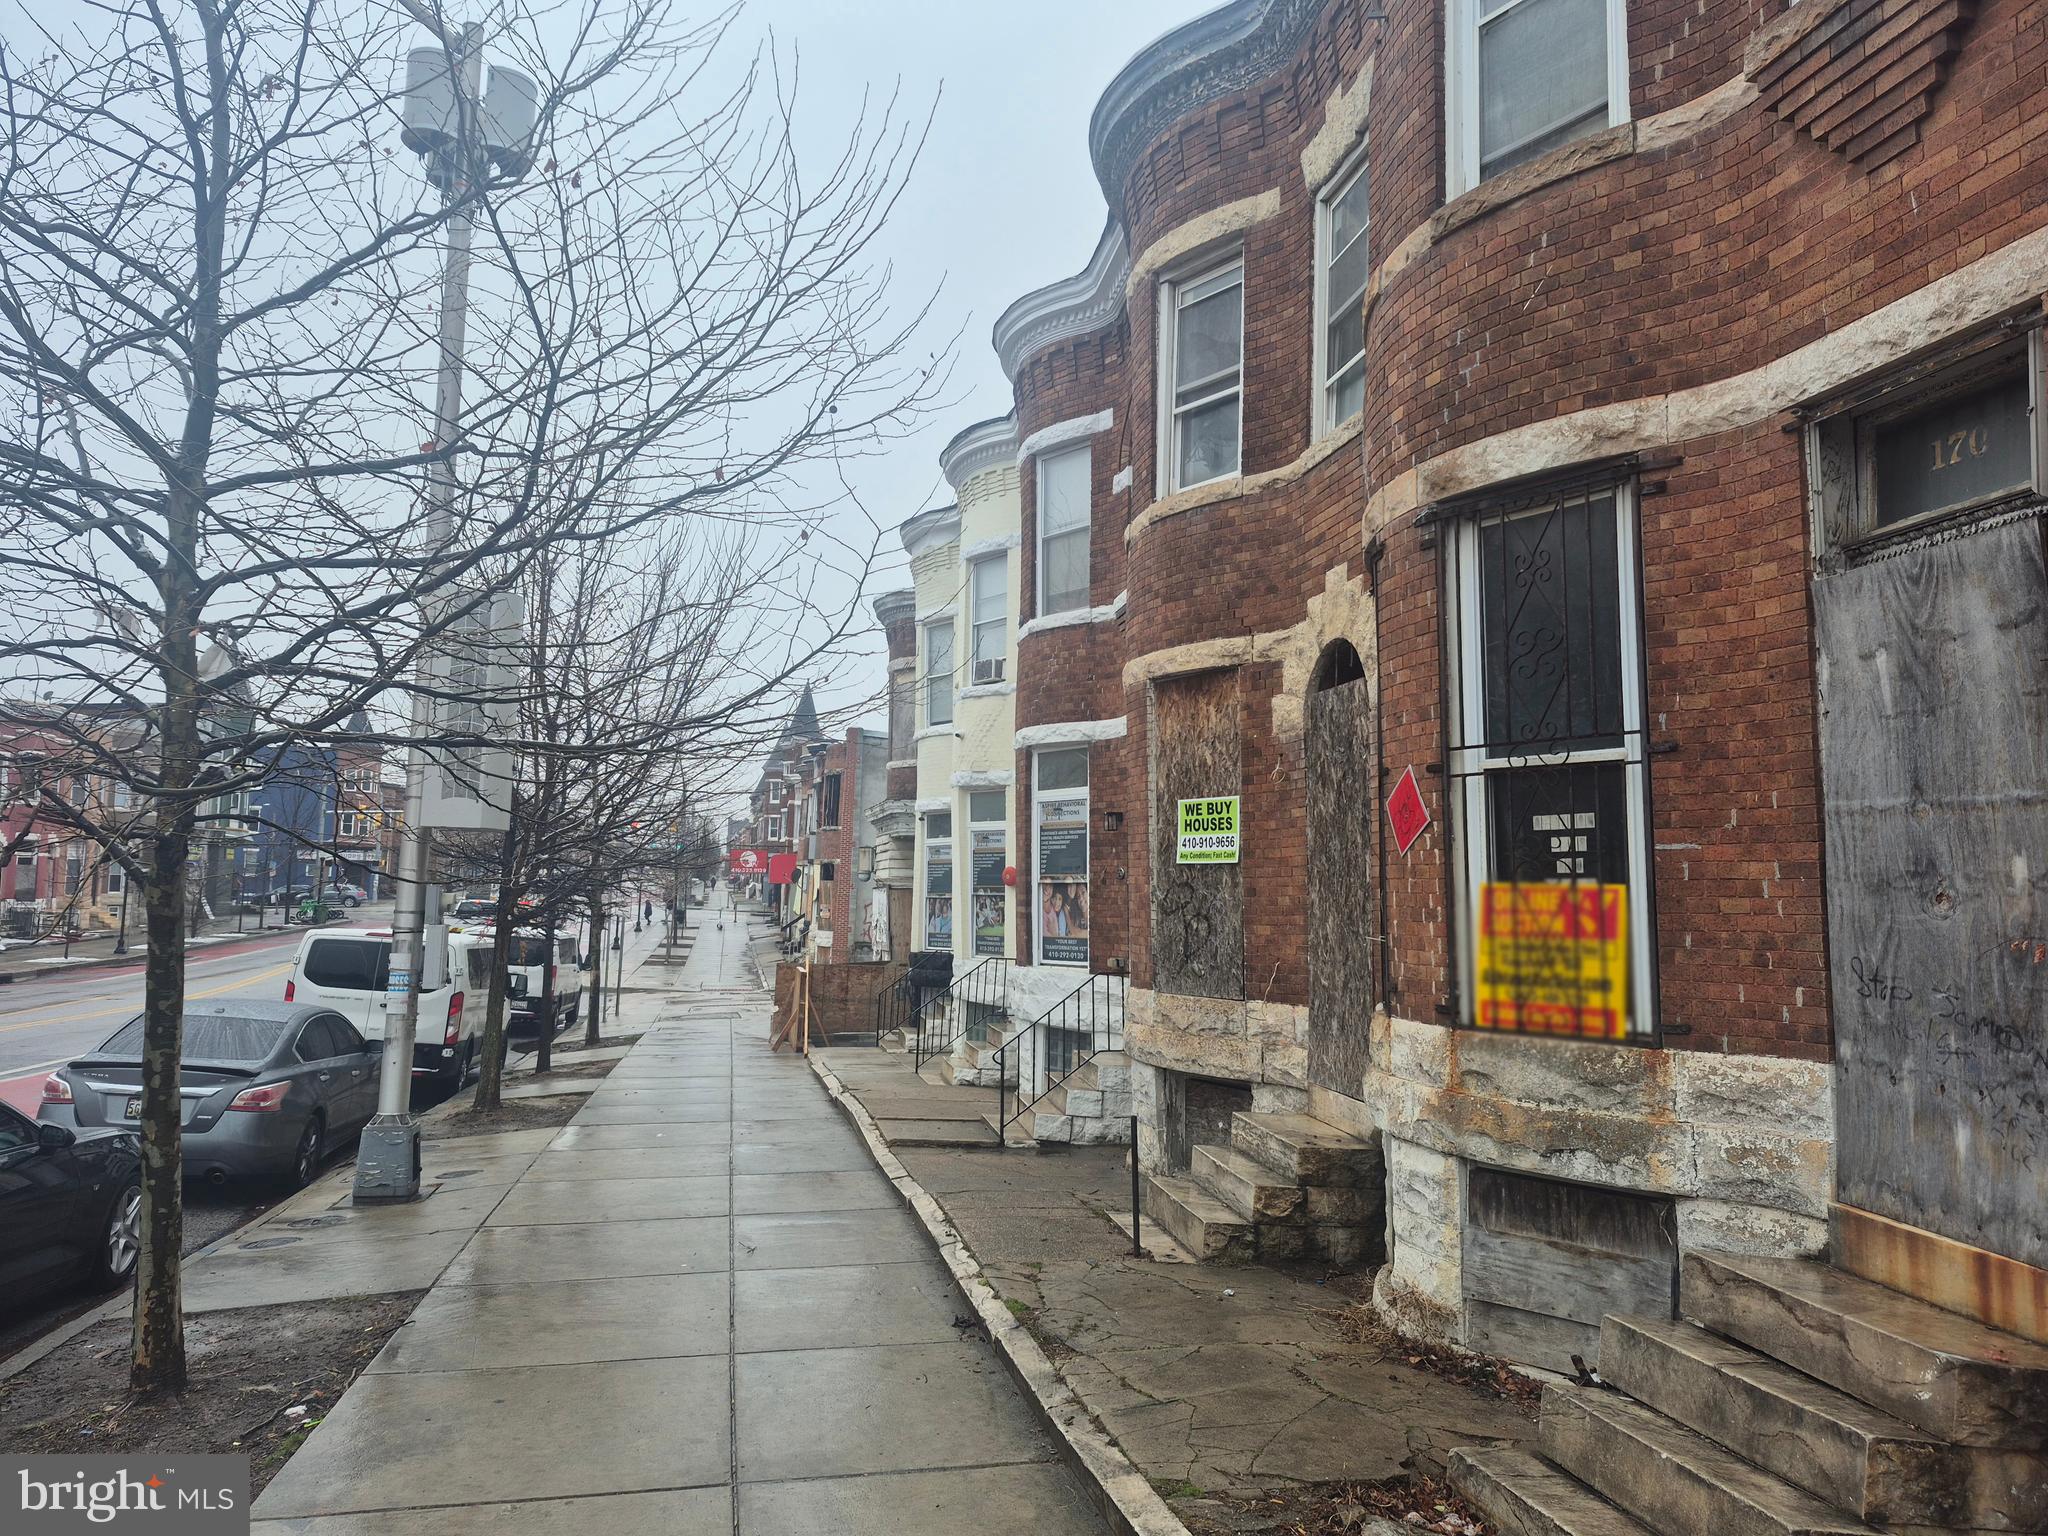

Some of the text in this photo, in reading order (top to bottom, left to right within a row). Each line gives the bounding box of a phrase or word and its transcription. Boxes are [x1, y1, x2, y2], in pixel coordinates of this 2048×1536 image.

[1184, 801, 1232, 816] WE BUY
[1184, 817, 1233, 832] HOUSES
[1181, 836, 1235, 849] 410-910-9656
[1180, 852, 1189, 860] Any
[1213, 851, 1223, 859] Fast
